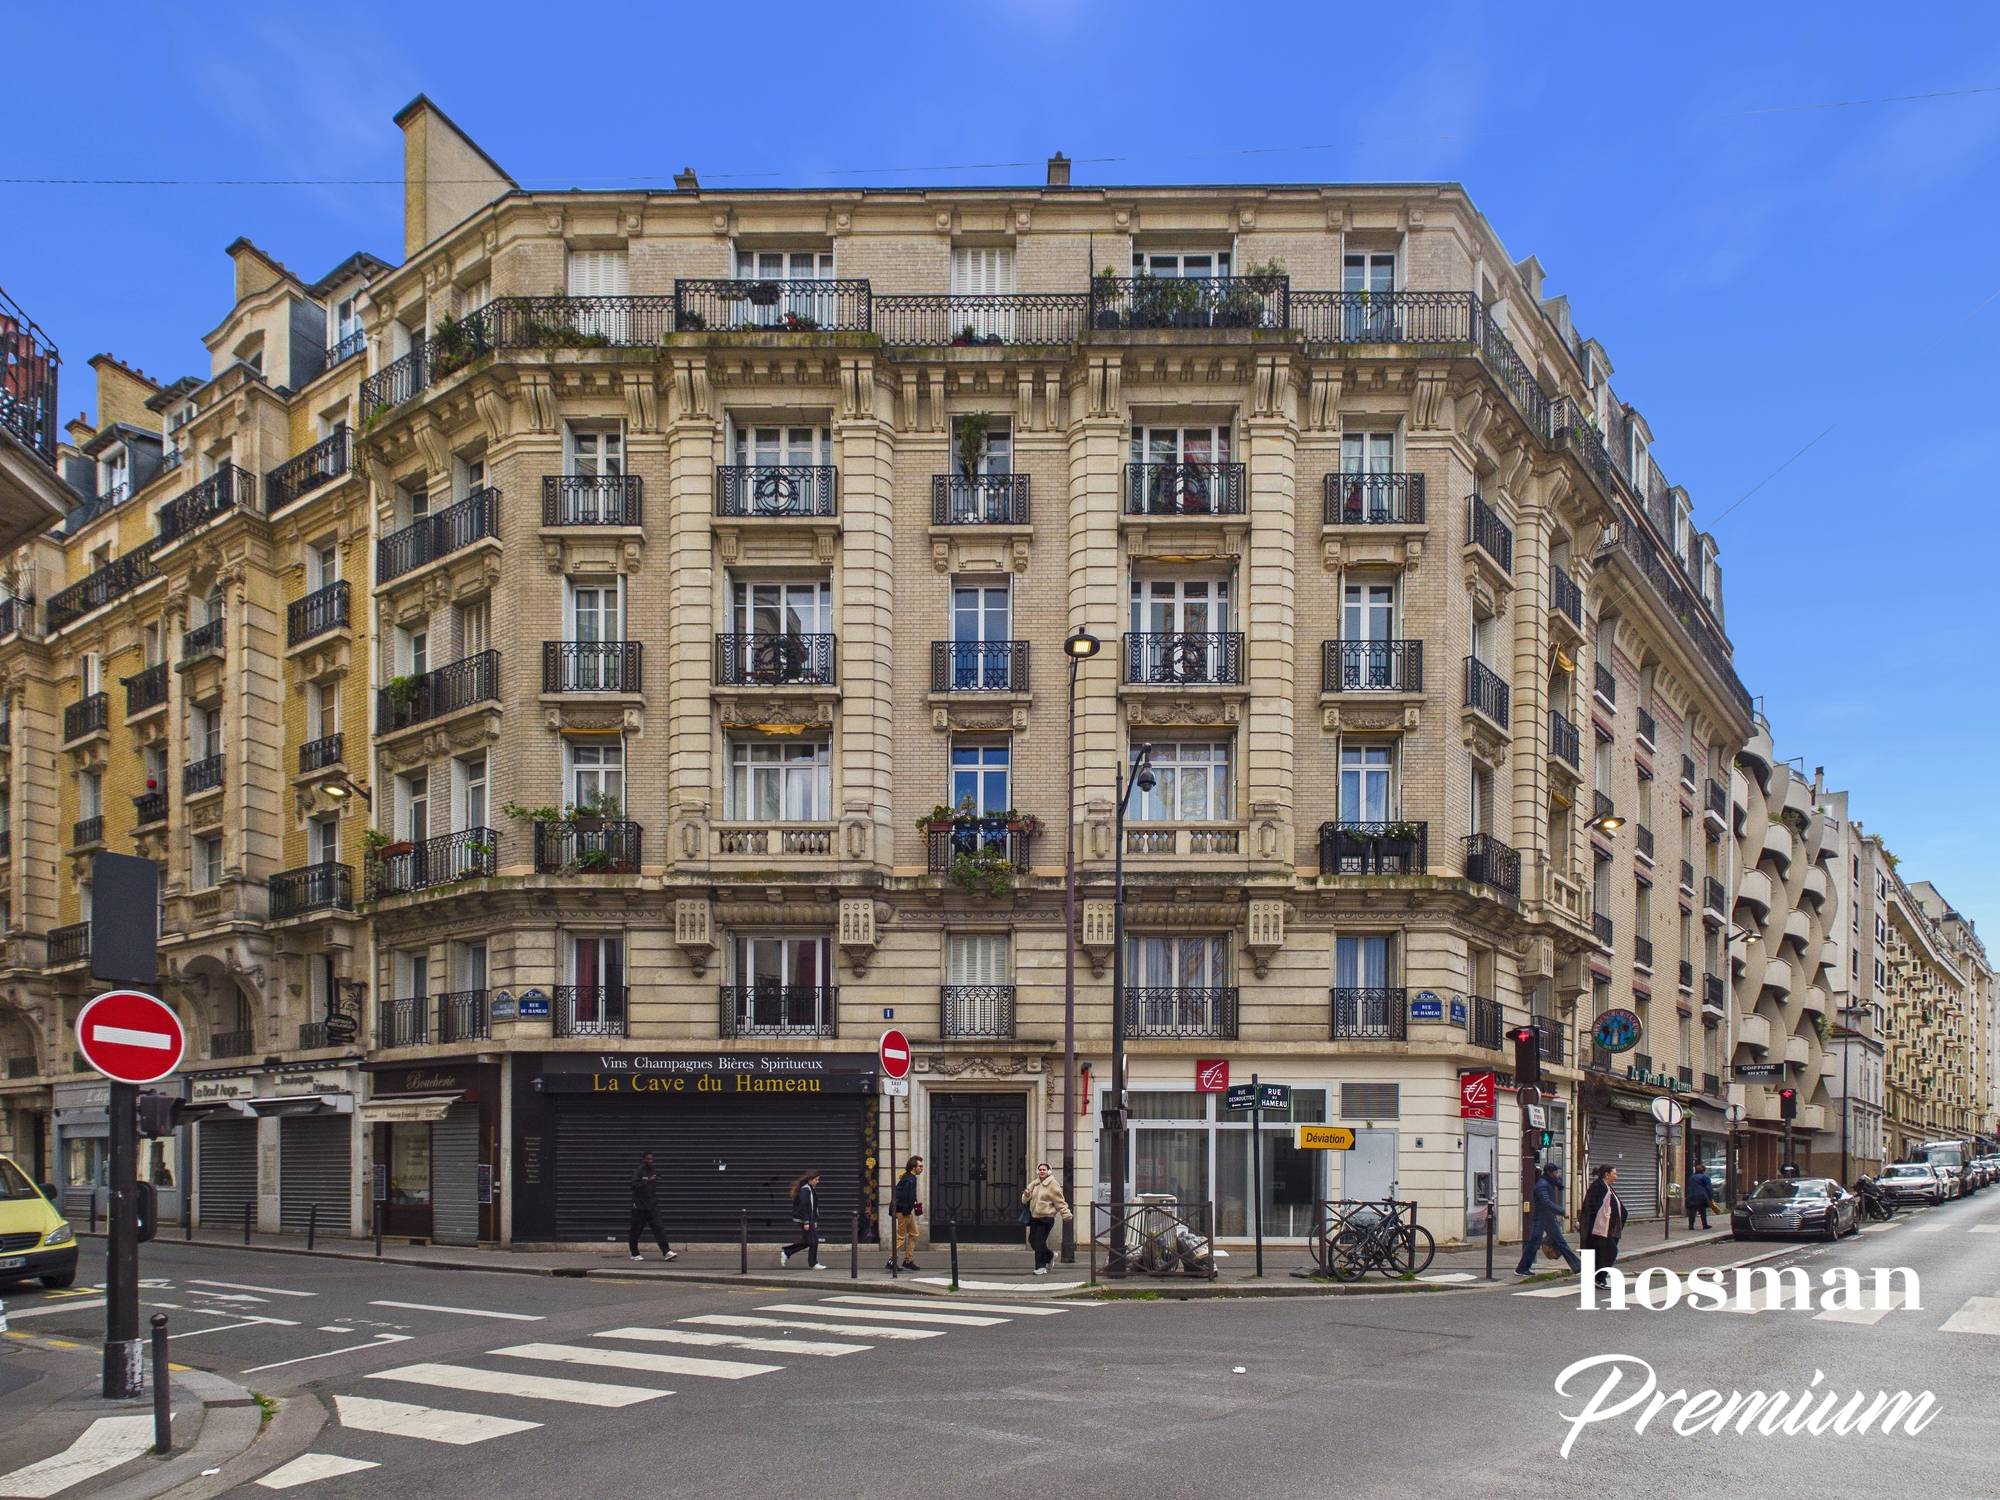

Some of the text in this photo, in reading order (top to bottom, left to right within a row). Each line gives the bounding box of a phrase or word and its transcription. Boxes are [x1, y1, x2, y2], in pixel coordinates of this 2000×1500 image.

[601, 1056, 823, 1072] Vins Champagnes Bières Spiritueux
[405, 1071, 456, 1090] Boucherie
[593, 1073, 821, 1092] La Cave du Hameau
[1267, 1088, 1282, 1096] RUE
[1261, 1099, 1288, 1108] HAMEAU
[1306, 1132, 1345, 1144] Déviation
